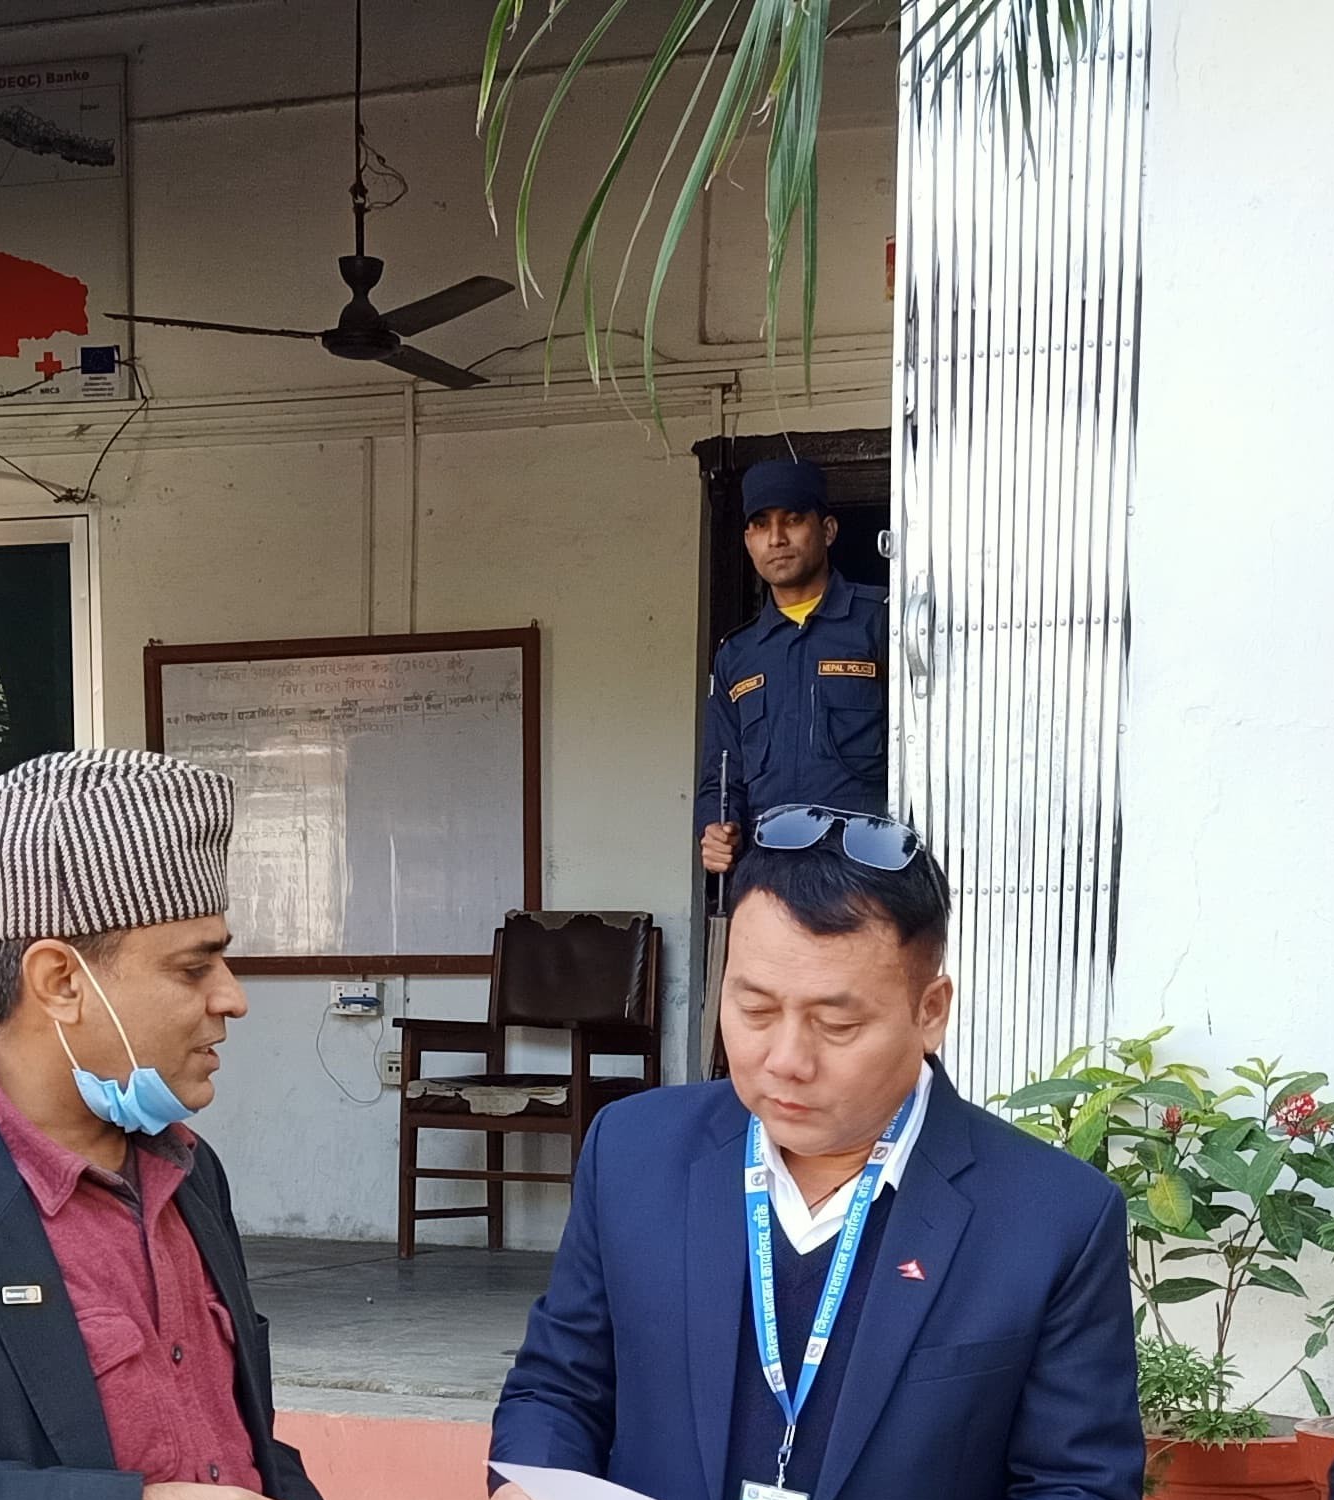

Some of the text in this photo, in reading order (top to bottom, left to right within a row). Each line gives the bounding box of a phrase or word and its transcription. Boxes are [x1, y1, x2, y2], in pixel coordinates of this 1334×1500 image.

[46, 69, 90, 84] Banke
[822, 662, 872, 674] NEPAL POLICE
[752, 1203, 770, 1228] बाँके
[814, 1295, 837, 1333] जिल्ला
[827, 1251, 850, 1294] प्रशासन
[855, 1174, 873, 1199] बाँके
[761, 1279, 776, 1321] प्रशासन
[766, 1322, 779, 1361] जिल्ला
